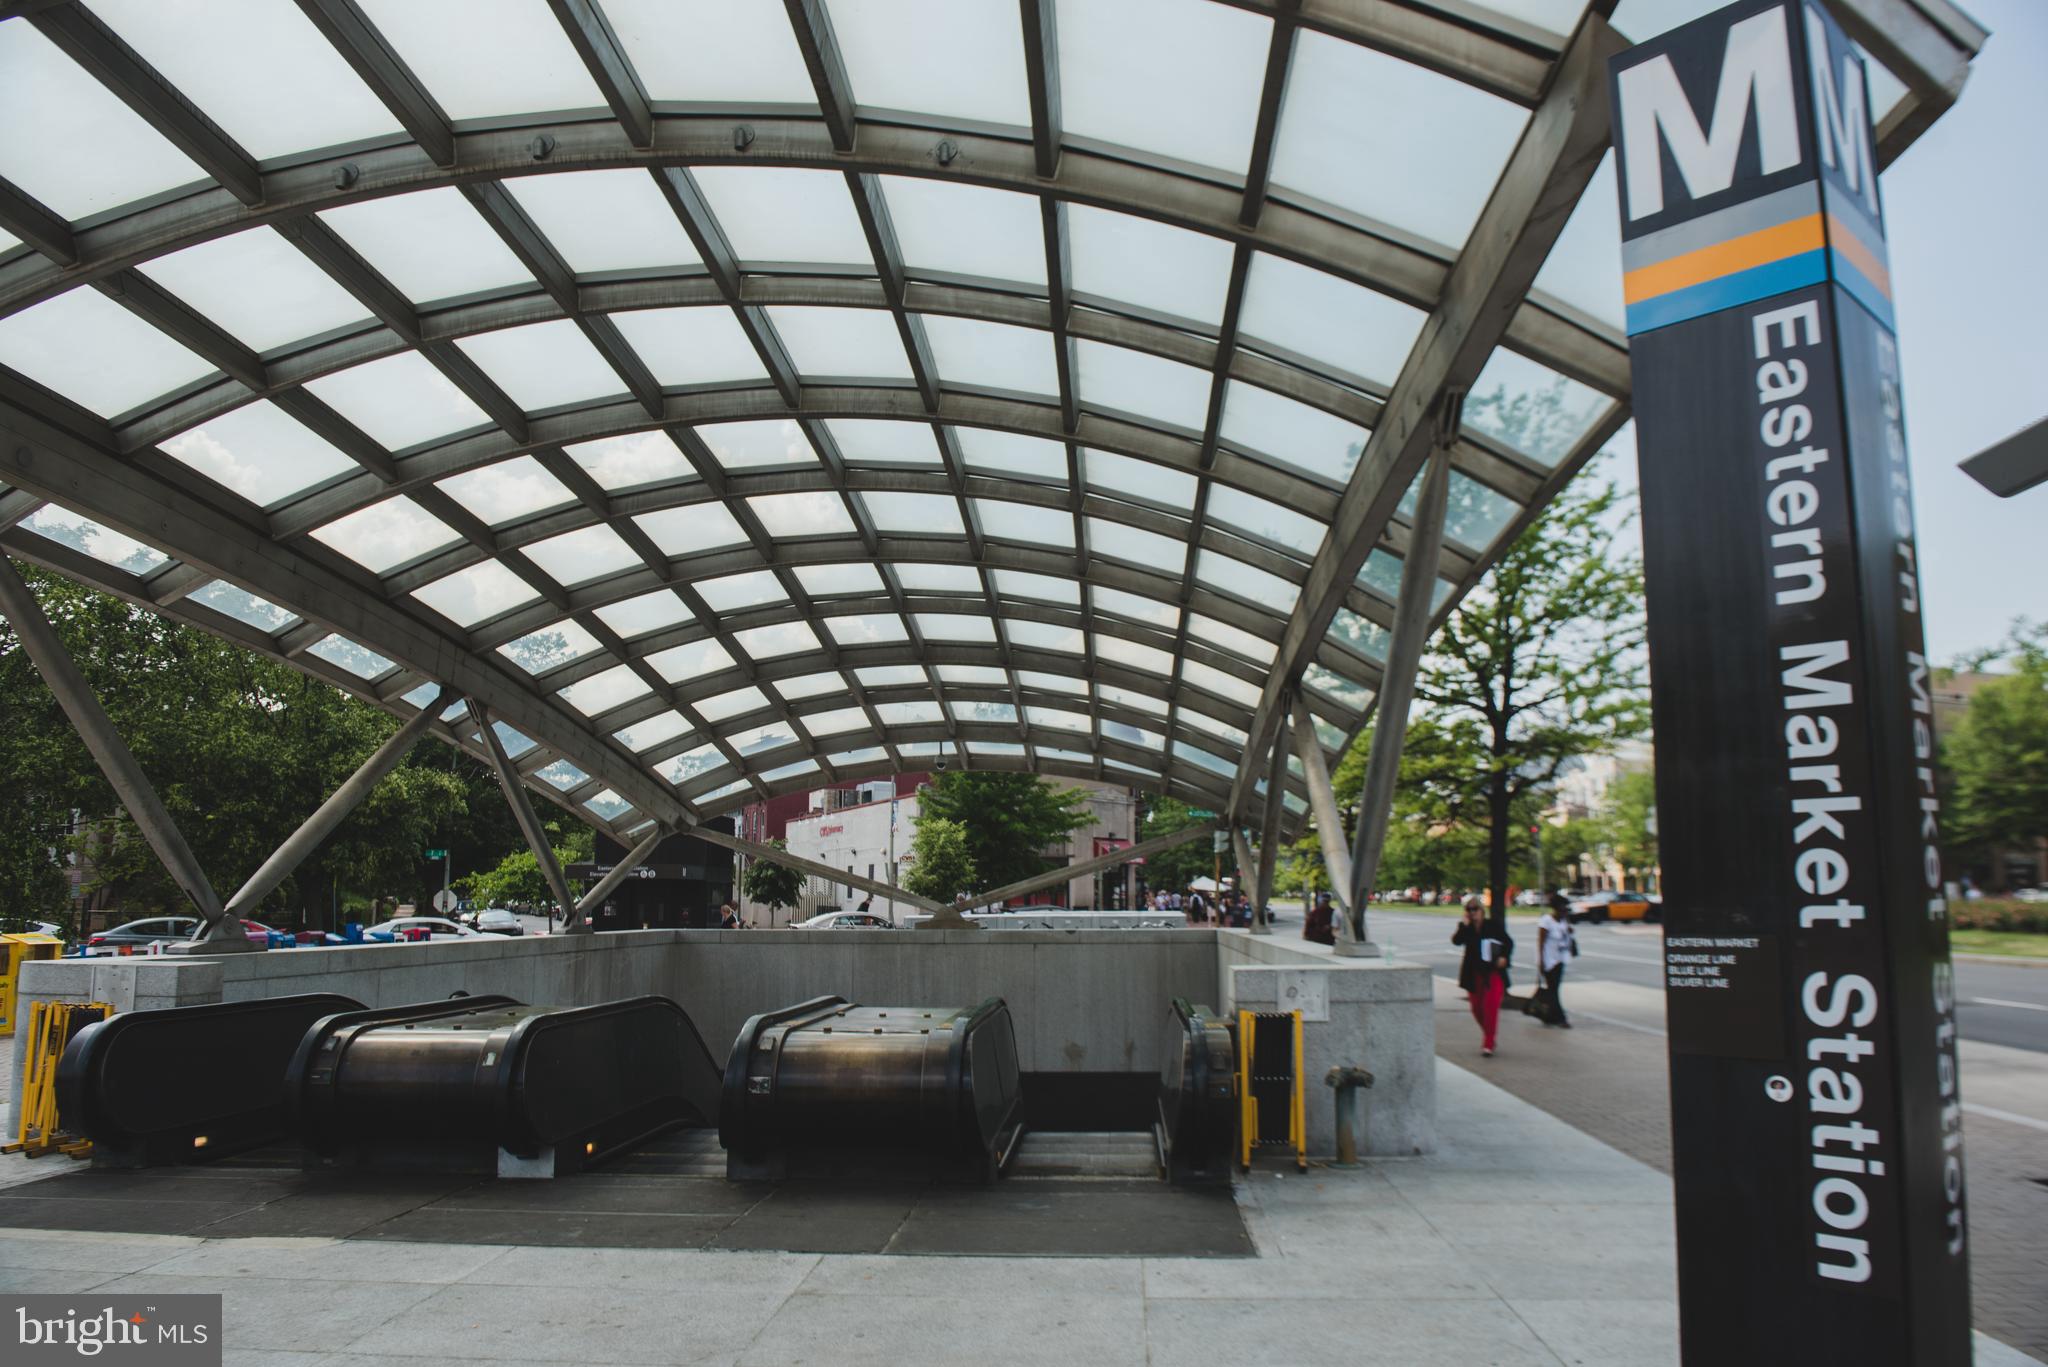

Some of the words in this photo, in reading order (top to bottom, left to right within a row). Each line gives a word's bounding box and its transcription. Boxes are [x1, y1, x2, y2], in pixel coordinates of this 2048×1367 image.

[1618, 4, 1801, 221] M
[1805, 7, 1880, 218] M
[1752, 300, 1829, 605] Eastern
[1780, 640, 1865, 928] Market
[1666, 937, 1713, 947] EASTERN
[1714, 938, 1760, 948] MARKET
[1667, 954, 1711, 964] ORANGE
[1712, 955, 1736, 965] LINE
[1667, 966, 1695, 976] BLUE
[1696, 967, 1720, 976] LINE
[1669, 978, 1703, 987] SILVER
[1705, 978, 1729, 988] LINE
[1802, 971, 1885, 1283] Station
